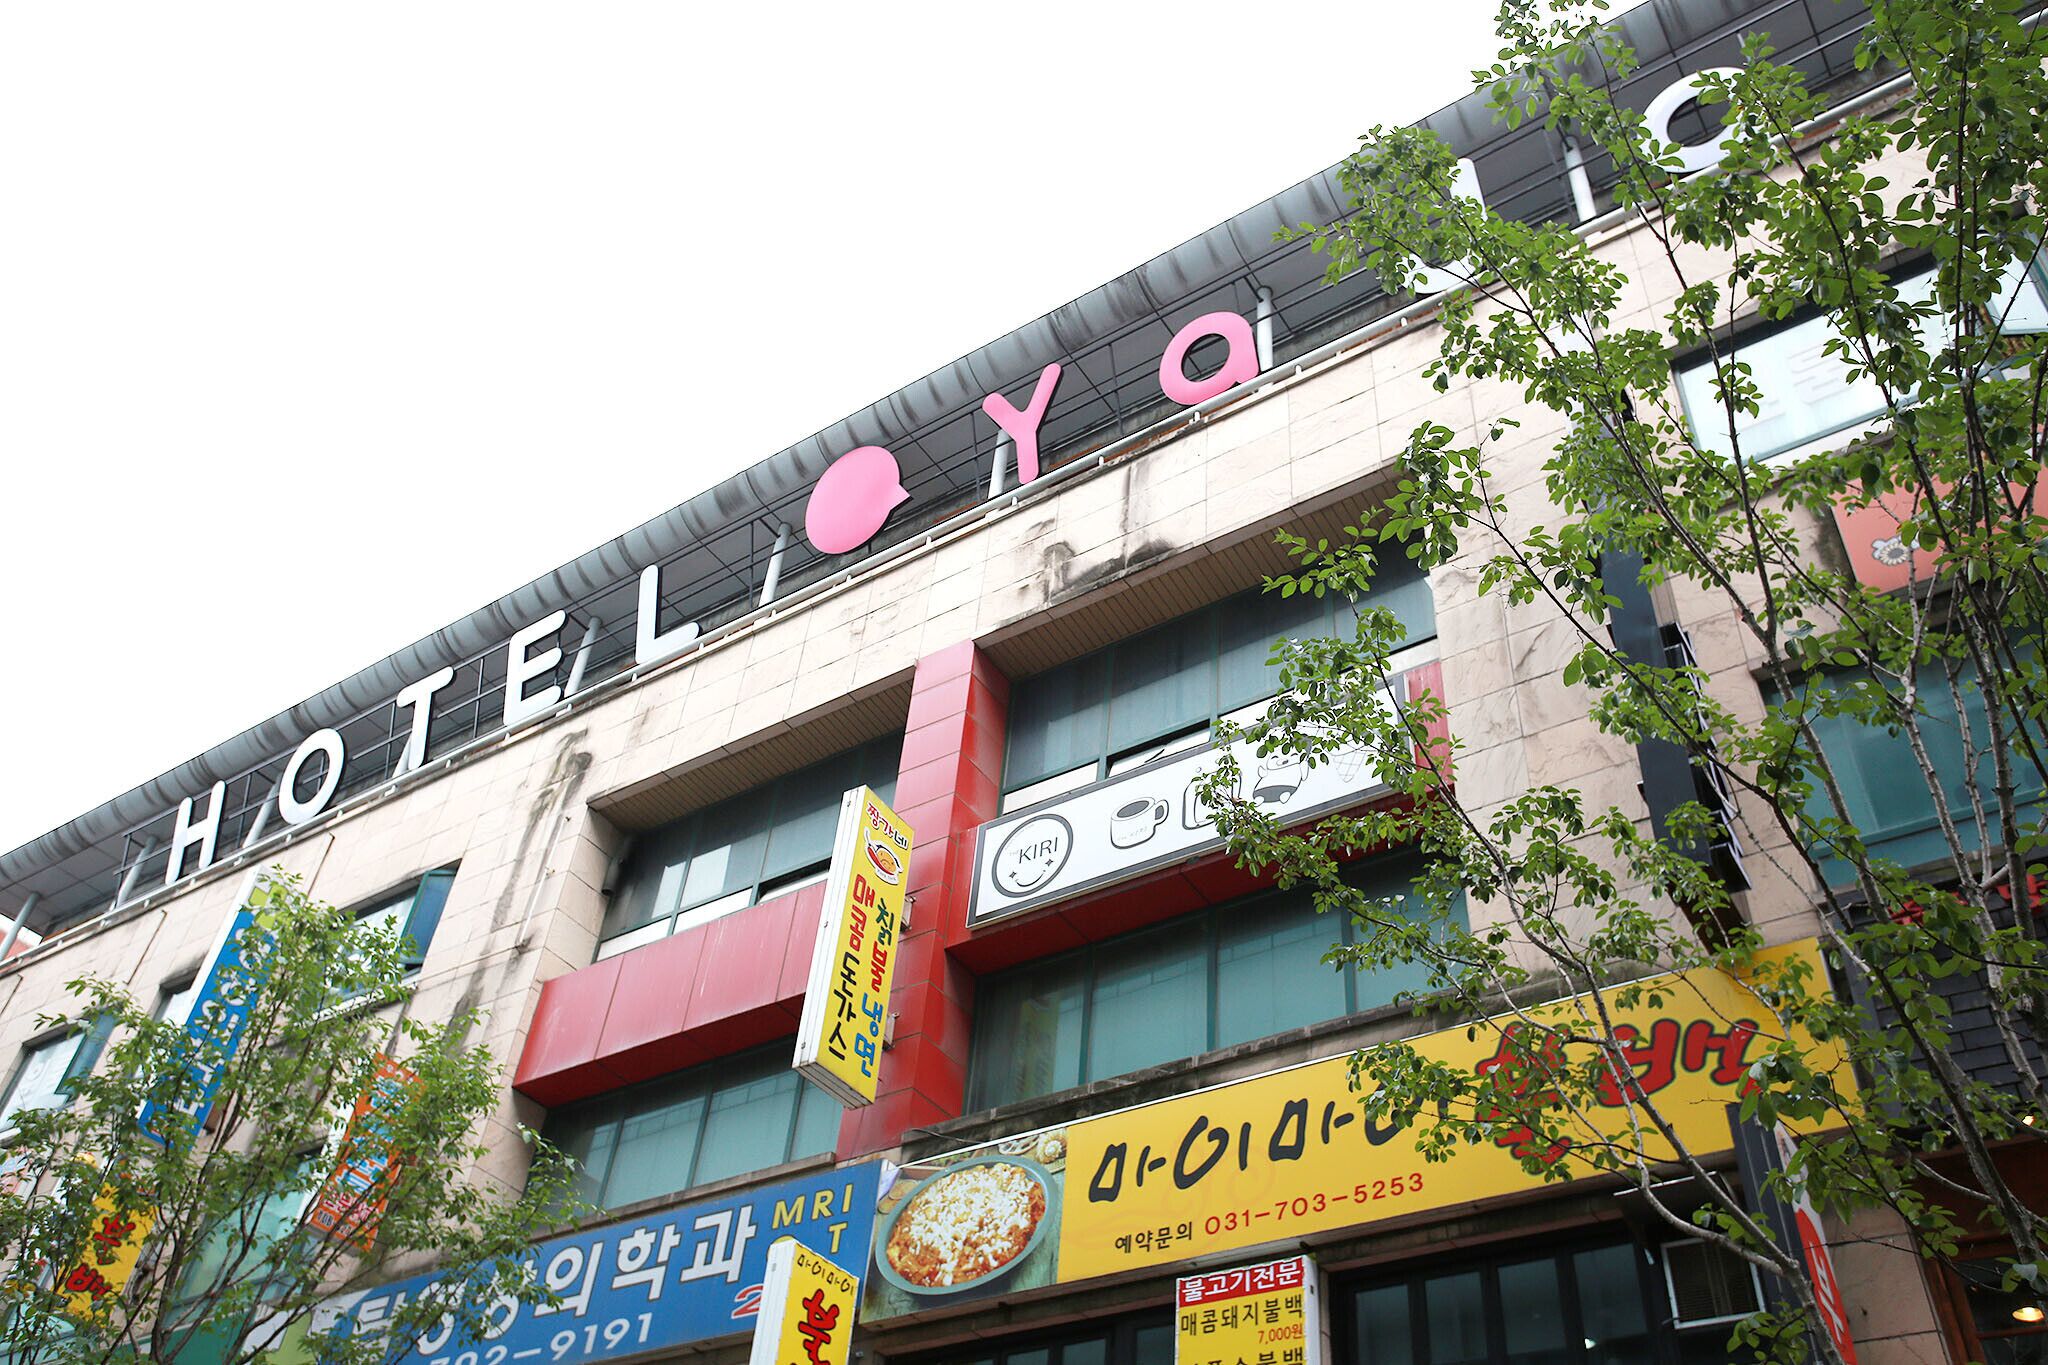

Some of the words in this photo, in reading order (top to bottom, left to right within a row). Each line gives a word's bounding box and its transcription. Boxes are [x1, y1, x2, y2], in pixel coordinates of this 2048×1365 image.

[166, 564, 700, 885] HOTEL
[866, 802, 909, 850] 짱가네
[1018, 837, 1058, 864] KIRI
[772, 1184, 854, 1229] MRI
[1115, 1221, 1193, 1254] 예약문의
[1205, 1173, 1424, 1235] 031-703-5253
[797, 1254, 855, 1296] 마이마이
[1182, 1261, 1300, 1302] 불고기전문
[1181, 1294, 1302, 1336] 매콤돼지불백
[1258, 1323, 1303, 1345] 7,000원
